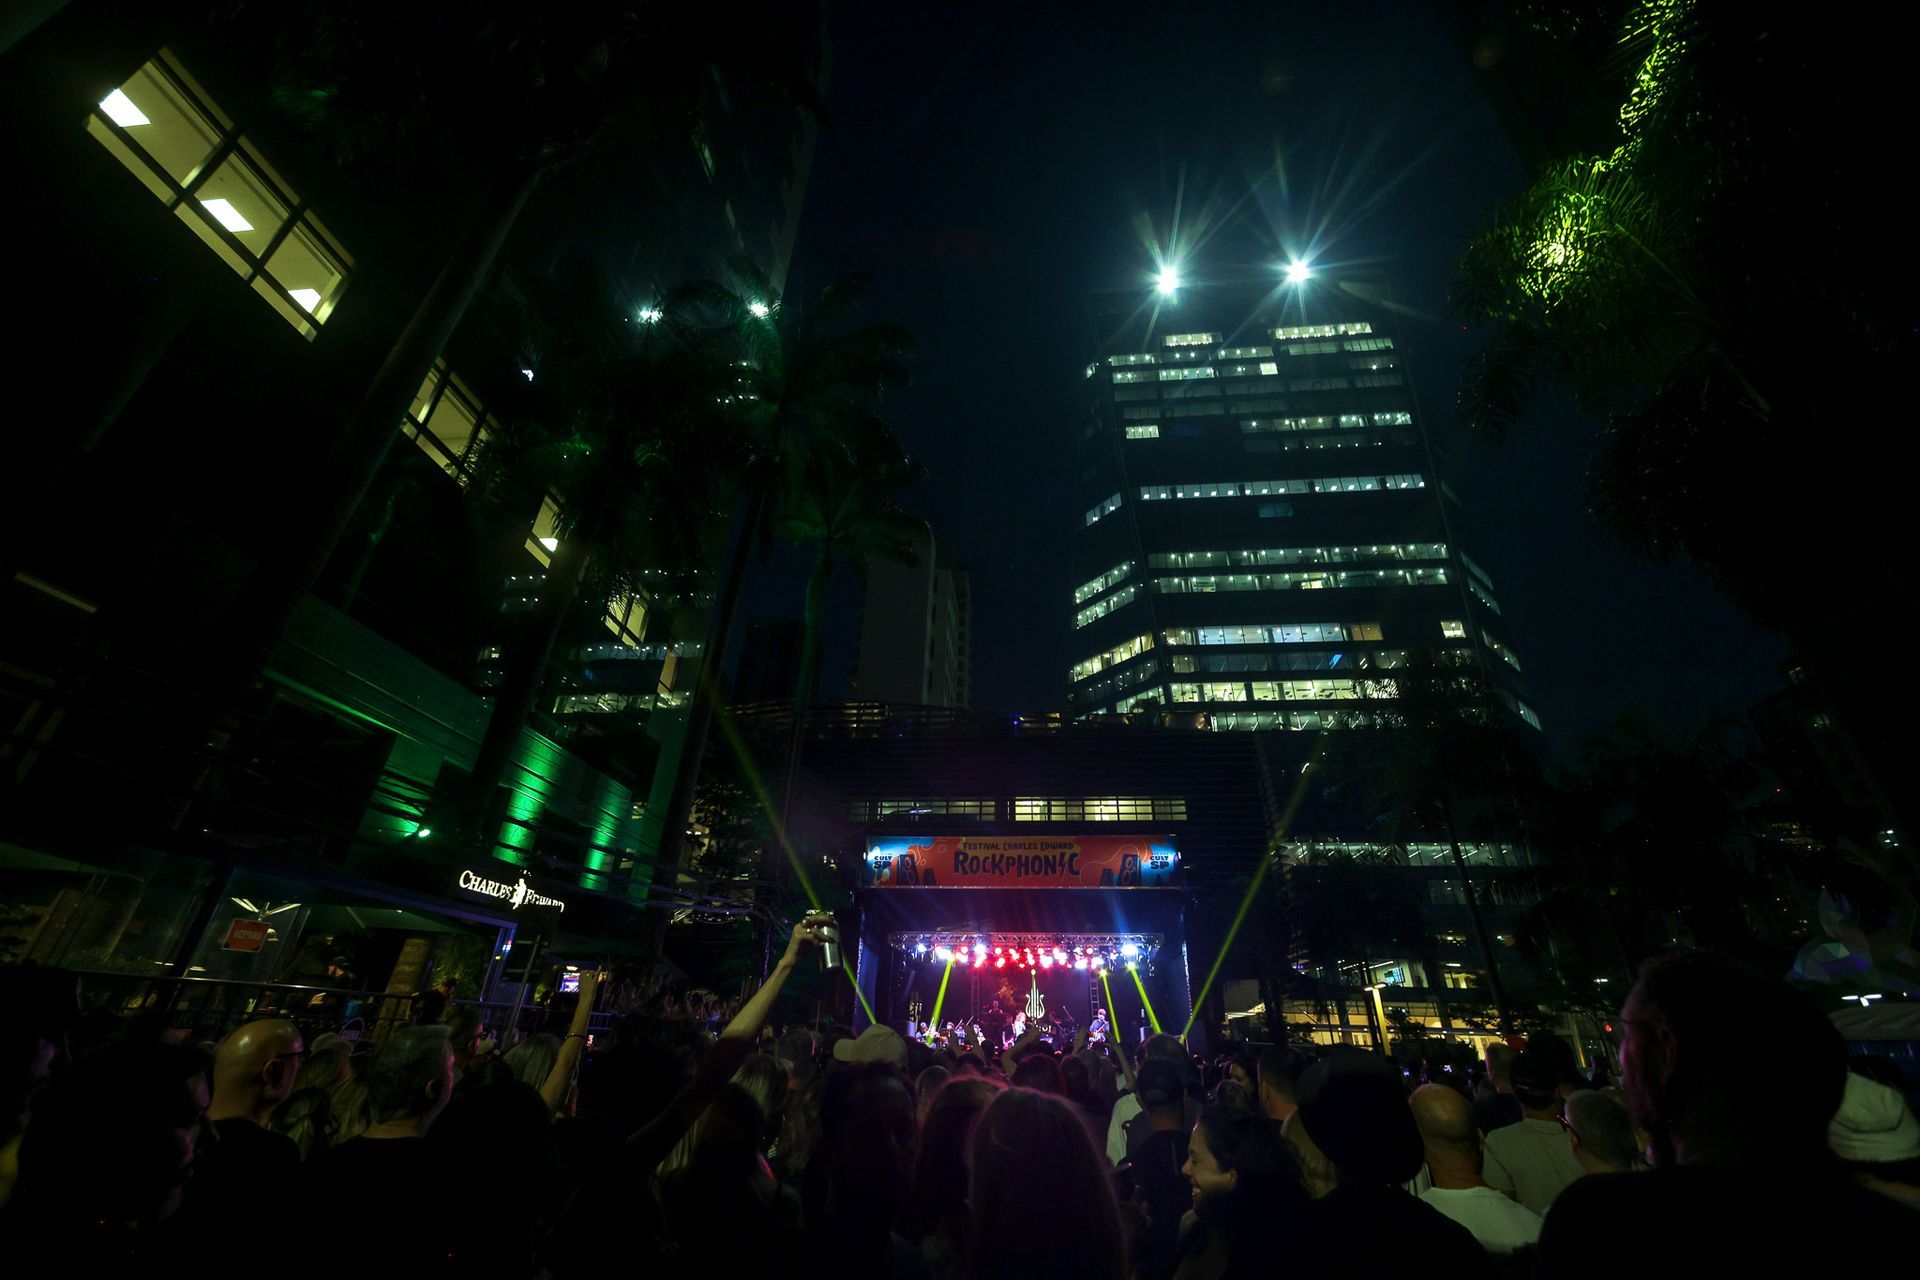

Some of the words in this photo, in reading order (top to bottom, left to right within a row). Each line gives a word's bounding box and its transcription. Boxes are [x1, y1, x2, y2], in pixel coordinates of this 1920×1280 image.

[963, 842, 1000, 851] FESTIVAL
[1003, 842, 1038, 851] CHARLES
[1040, 841, 1074, 851] EDWARD
[873, 861, 892, 869] SP
[1150, 861, 1170, 870] SP
[459, 870, 513, 900] CHARLES
